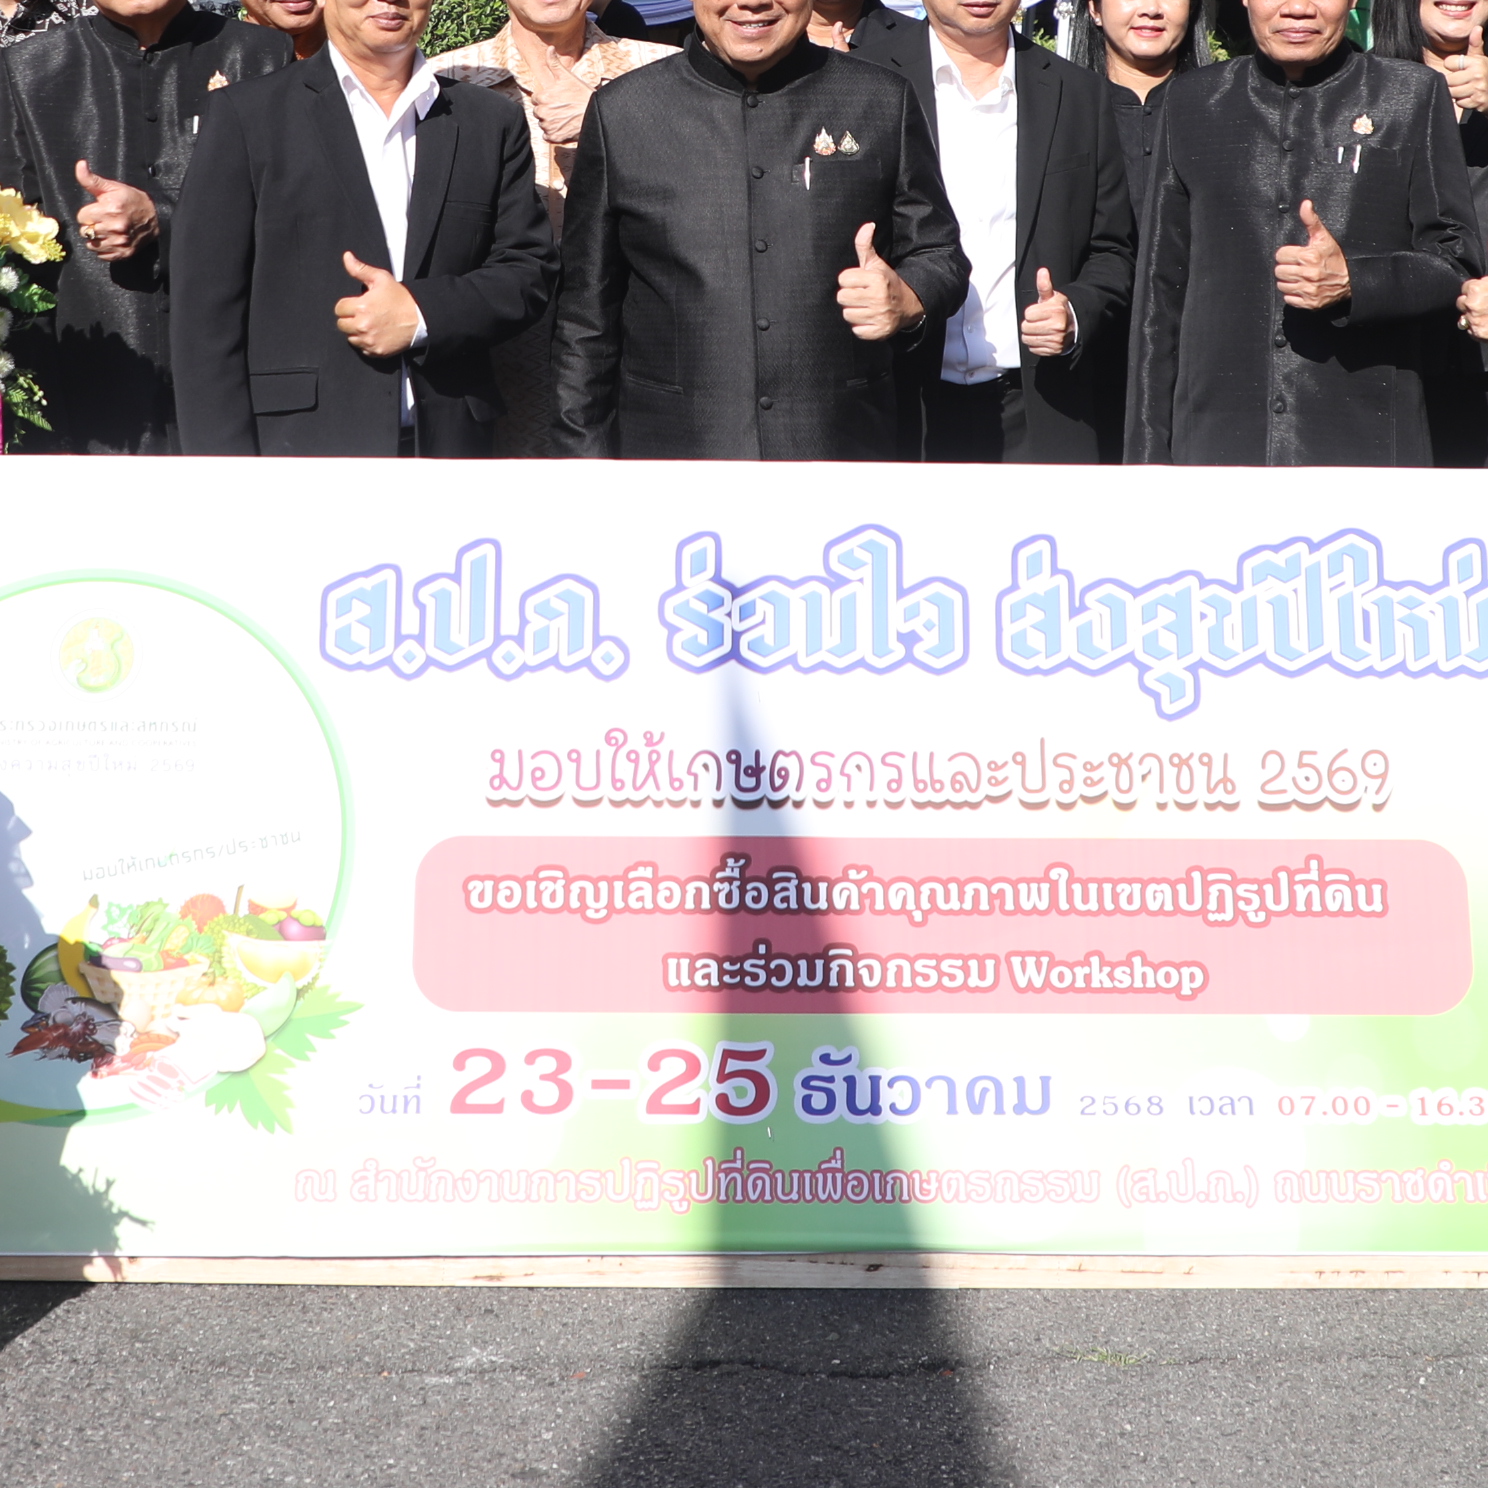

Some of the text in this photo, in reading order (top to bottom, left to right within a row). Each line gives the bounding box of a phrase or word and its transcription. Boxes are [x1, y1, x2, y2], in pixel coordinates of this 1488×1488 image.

[659, 524, 969, 675] ร่วมใจ
[487, 727, 1392, 800] มอบให้เกษตรกรและประชาชน 2569
[467, 857, 1383, 923] ขอเชิญเลือกซื้อสินค้าคุณภาพในเขตปฏิรูปที่ดิน
[665, 944, 1207, 994] และร่วมกิจกรรม Workshop
[358, 1074, 422, 1115] วันที่
[449, 1048, 771, 1117] 23-25
[800, 1051, 1052, 1117] ธันวาคม
[1079, 1094, 1164, 1117] 2568
[1187, 1094, 1256, 1117] เวลา
[1277, 1094, 1372, 1117] 07.00
[350, 1148, 1102, 1213] สำนักงานการปฏิรูปที่ดินเพื่อเกษตรกรรม
